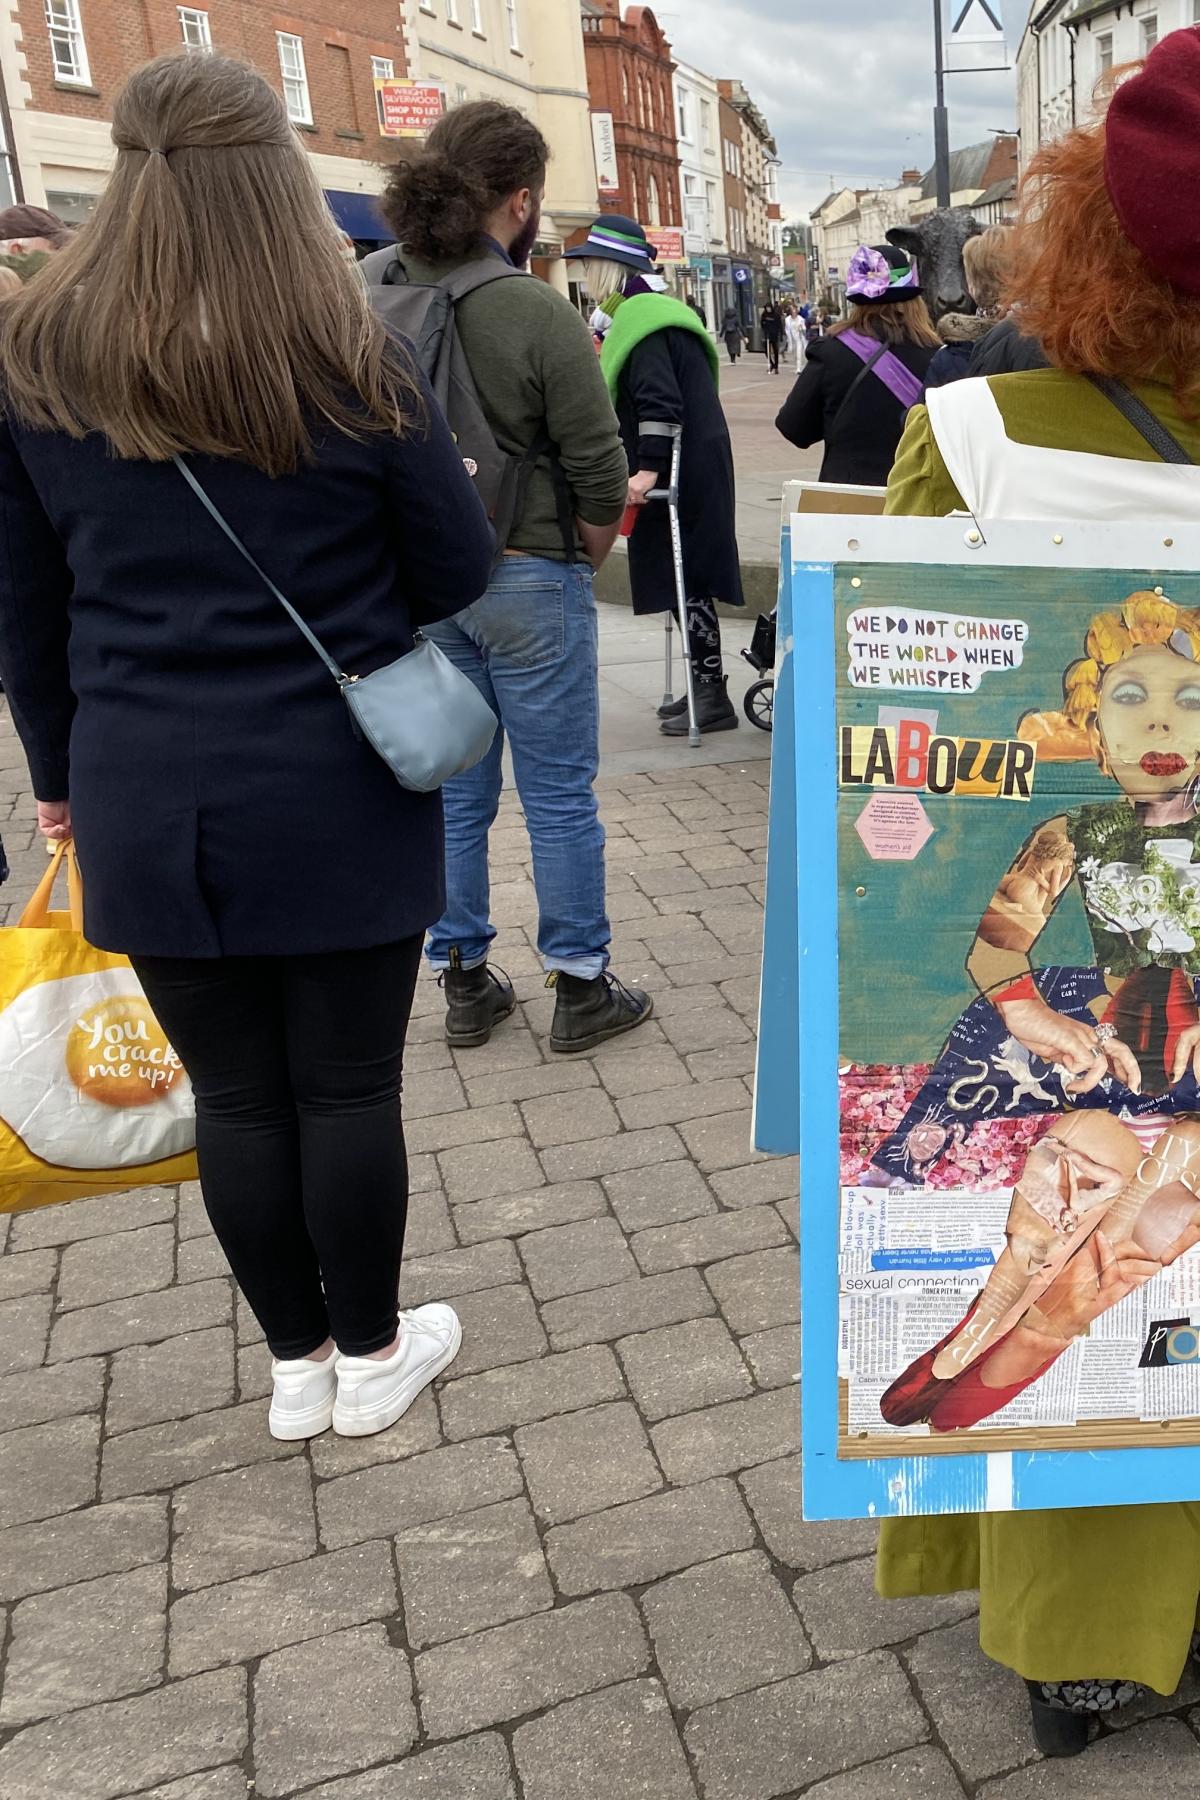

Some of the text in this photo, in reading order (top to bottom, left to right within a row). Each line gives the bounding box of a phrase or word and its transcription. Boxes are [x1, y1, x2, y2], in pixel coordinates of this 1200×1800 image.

[393, 88, 428, 96] WRIGHT
[386, 106, 410, 114] SHOP
[412, 106, 424, 115] TO
[854, 616, 1024, 642] WE DO NOT CHANGE
[854, 642, 1014, 667] THE WORLD WHEN
[854, 666, 973, 690] WE WHISPER
[76, 1013, 150, 1050] You
[103, 1043, 184, 1070] crack
[88, 1062, 174, 1089] me up!
[844, 1190, 856, 1230] blow-up
[846, 1276, 979, 1290] sexual connection
